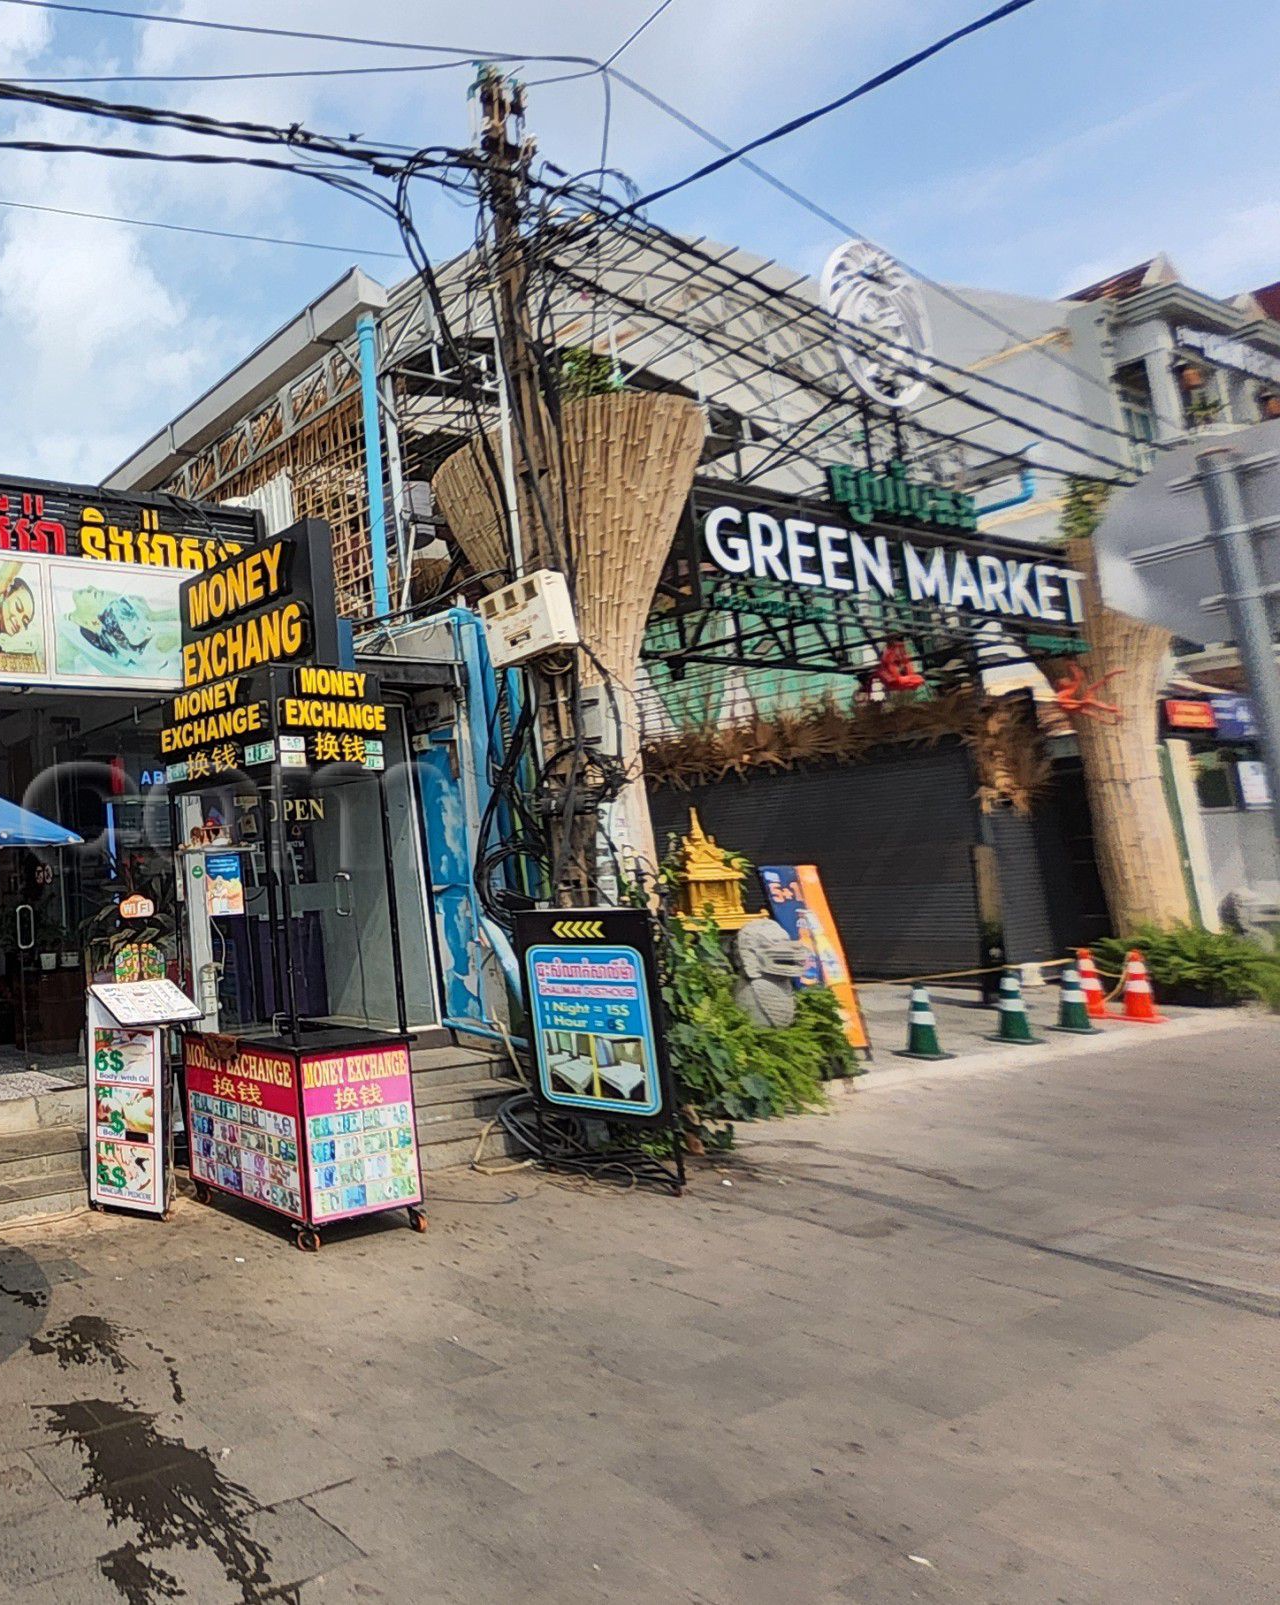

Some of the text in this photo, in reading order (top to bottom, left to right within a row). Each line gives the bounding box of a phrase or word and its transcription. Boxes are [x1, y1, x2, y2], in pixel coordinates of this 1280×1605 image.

[704, 506, 1086, 623] GREEN MARKET
[188, 541, 282, 629] MONEY
[183, 603, 301, 688] EXCHANG
[299, 667, 366, 698] MONEY
[174, 678, 239, 721] MONEY
[285, 699, 386, 731] EXCHANGE
[162, 704, 261, 753] EXCHANGE
[186, 743, 238, 781] 换钱
[315, 731, 366, 763] 换钱
[141, 770, 166, 785] AB
[543, 1001, 550, 1011] 1
[552, 1001, 590, 1016] Night
[545, 1015, 551, 1025] 1
[554, 1015, 588, 1028] Hour
[95, 1049, 124, 1073] 6$
[302, 1050, 408, 1089] MONEY EXCHANGE
[212, 1074, 263, 1107] 换钱
[334, 1082, 383, 1111] 换钱
